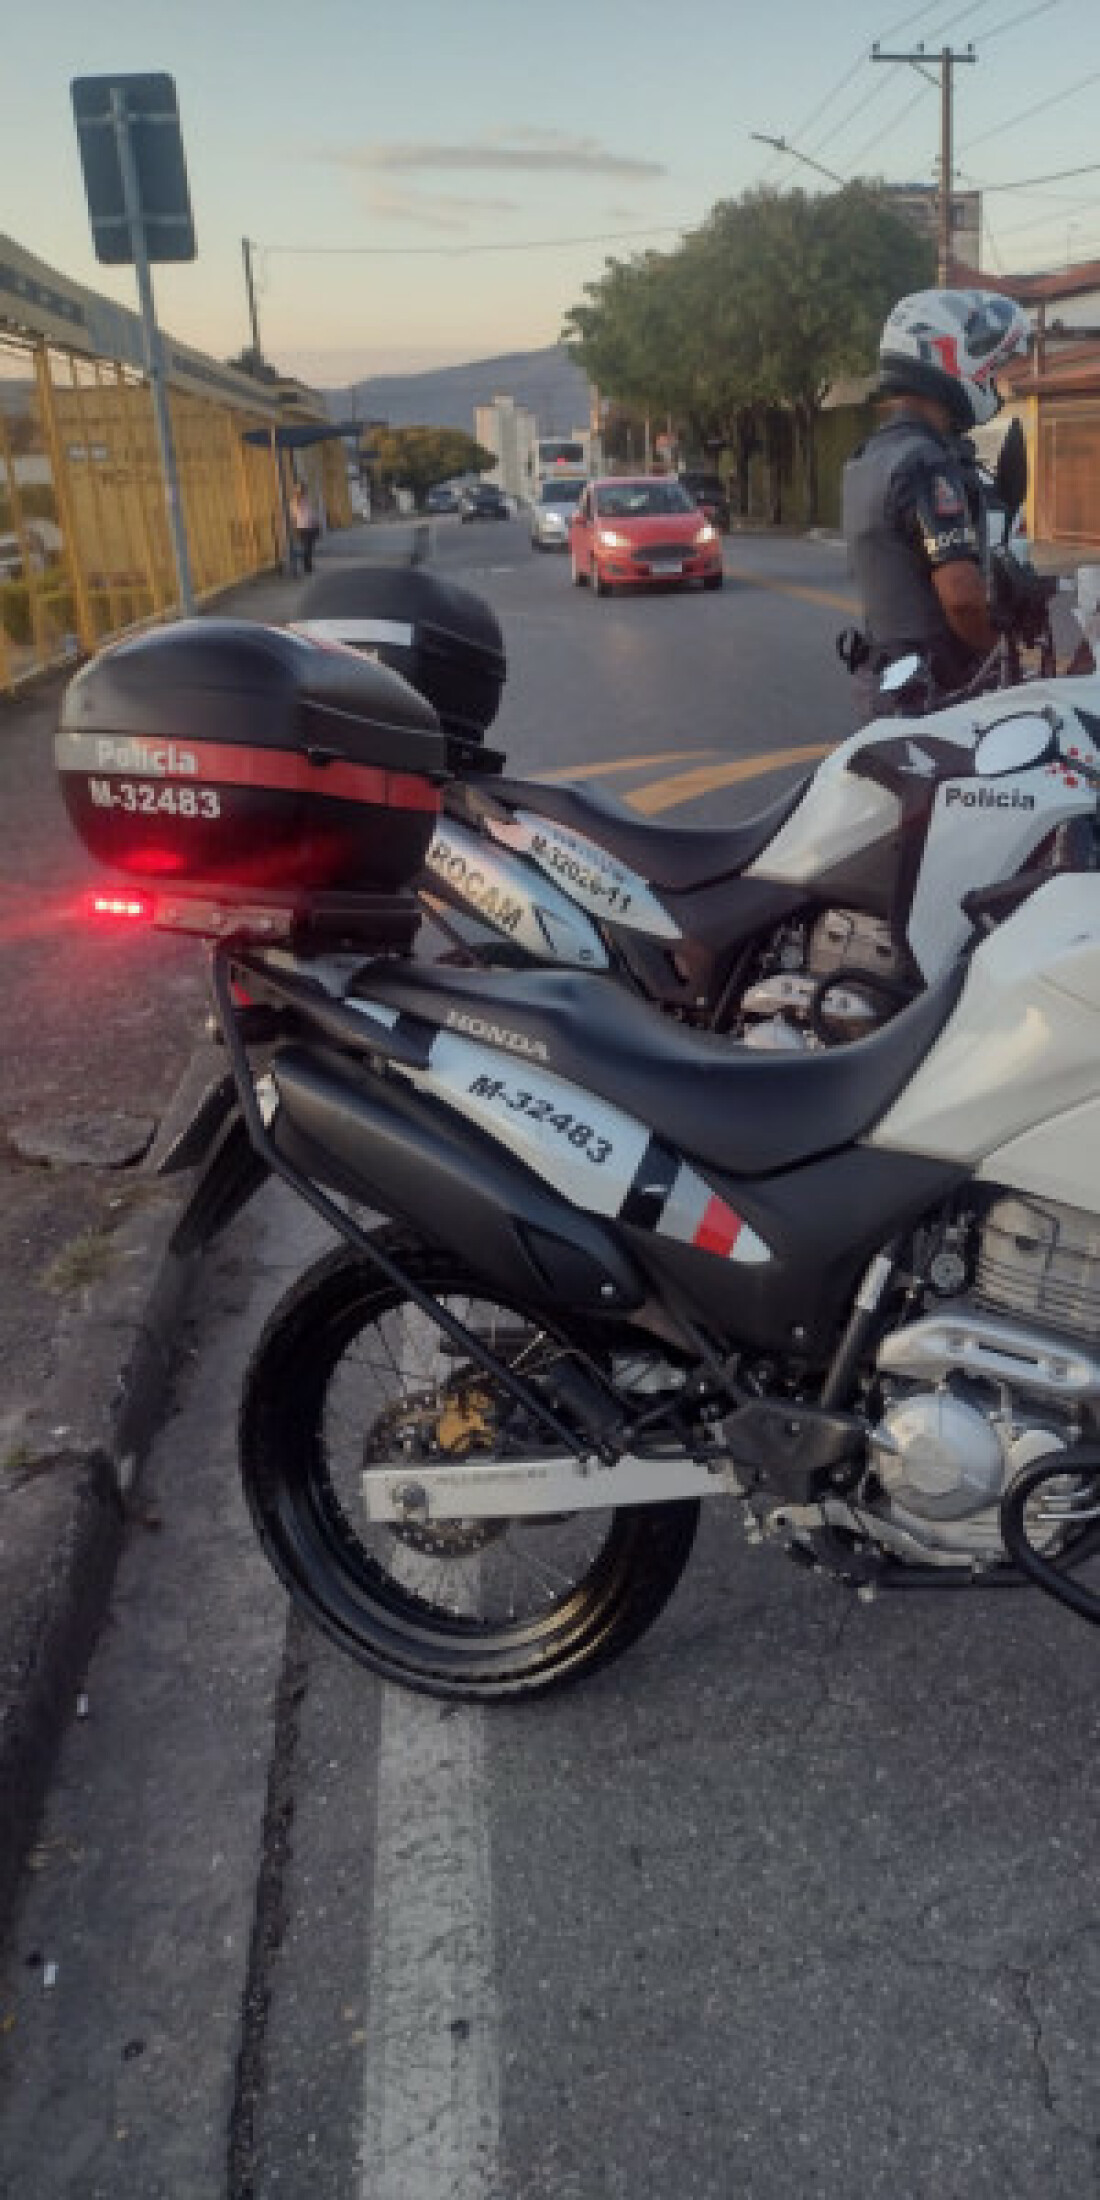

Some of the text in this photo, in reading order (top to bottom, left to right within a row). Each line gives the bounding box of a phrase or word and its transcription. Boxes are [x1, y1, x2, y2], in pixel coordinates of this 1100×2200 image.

[88, 777, 221, 819] M-32483
[425, 838, 524, 932] ROCAM
[446, 1009, 549, 1061] HONDA
[467, 1074, 613, 1165] M-32483
